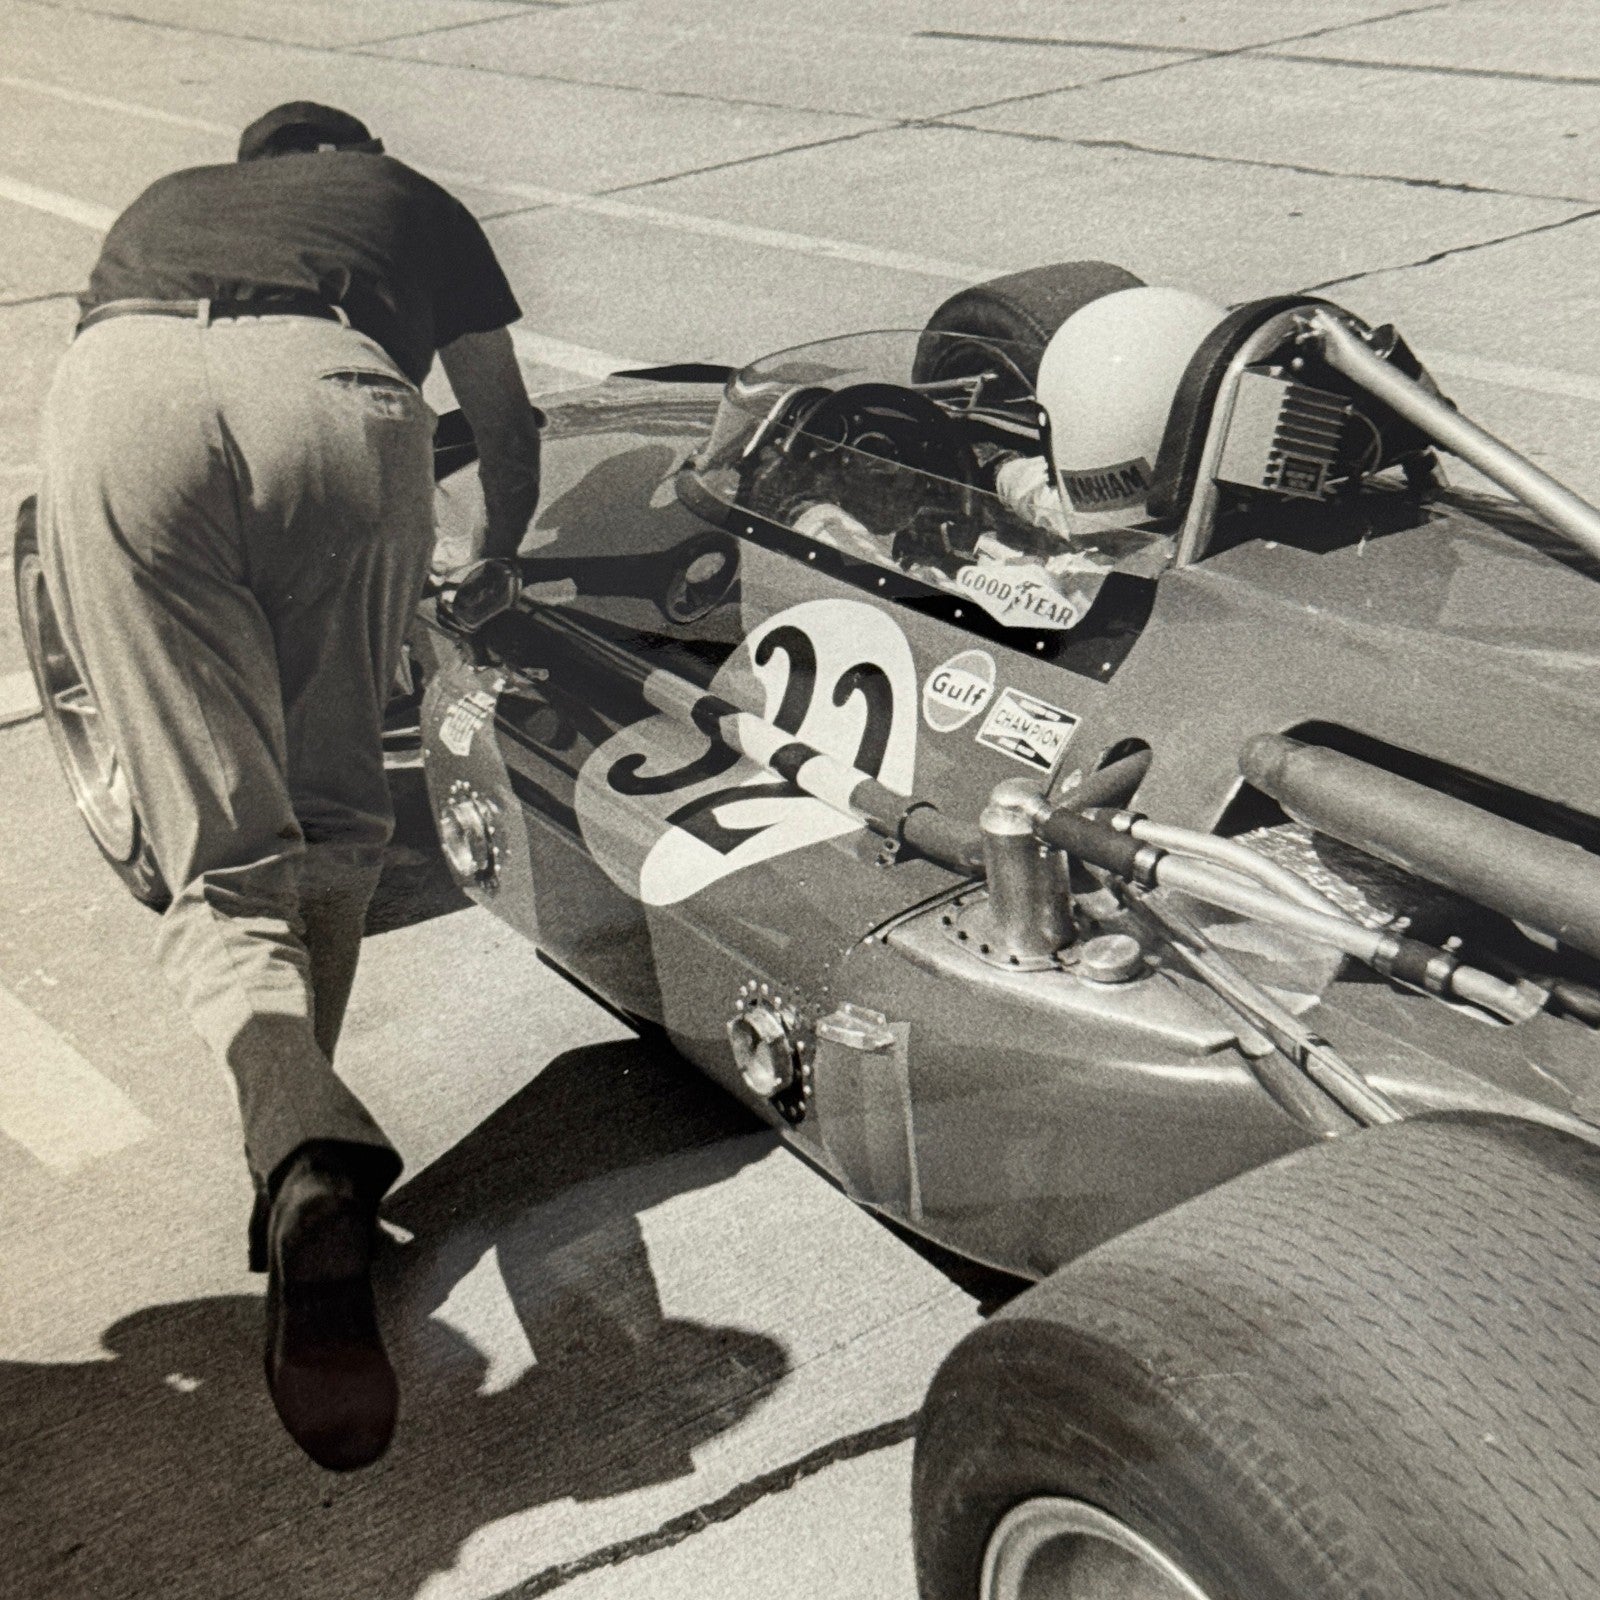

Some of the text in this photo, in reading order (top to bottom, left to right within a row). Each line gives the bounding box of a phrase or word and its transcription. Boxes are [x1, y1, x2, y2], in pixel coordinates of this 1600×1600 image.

[961, 569, 1073, 626] GOODYEAR
[932, 672, 986, 706] Gulf
[994, 709, 1061, 748] CHAMPION
